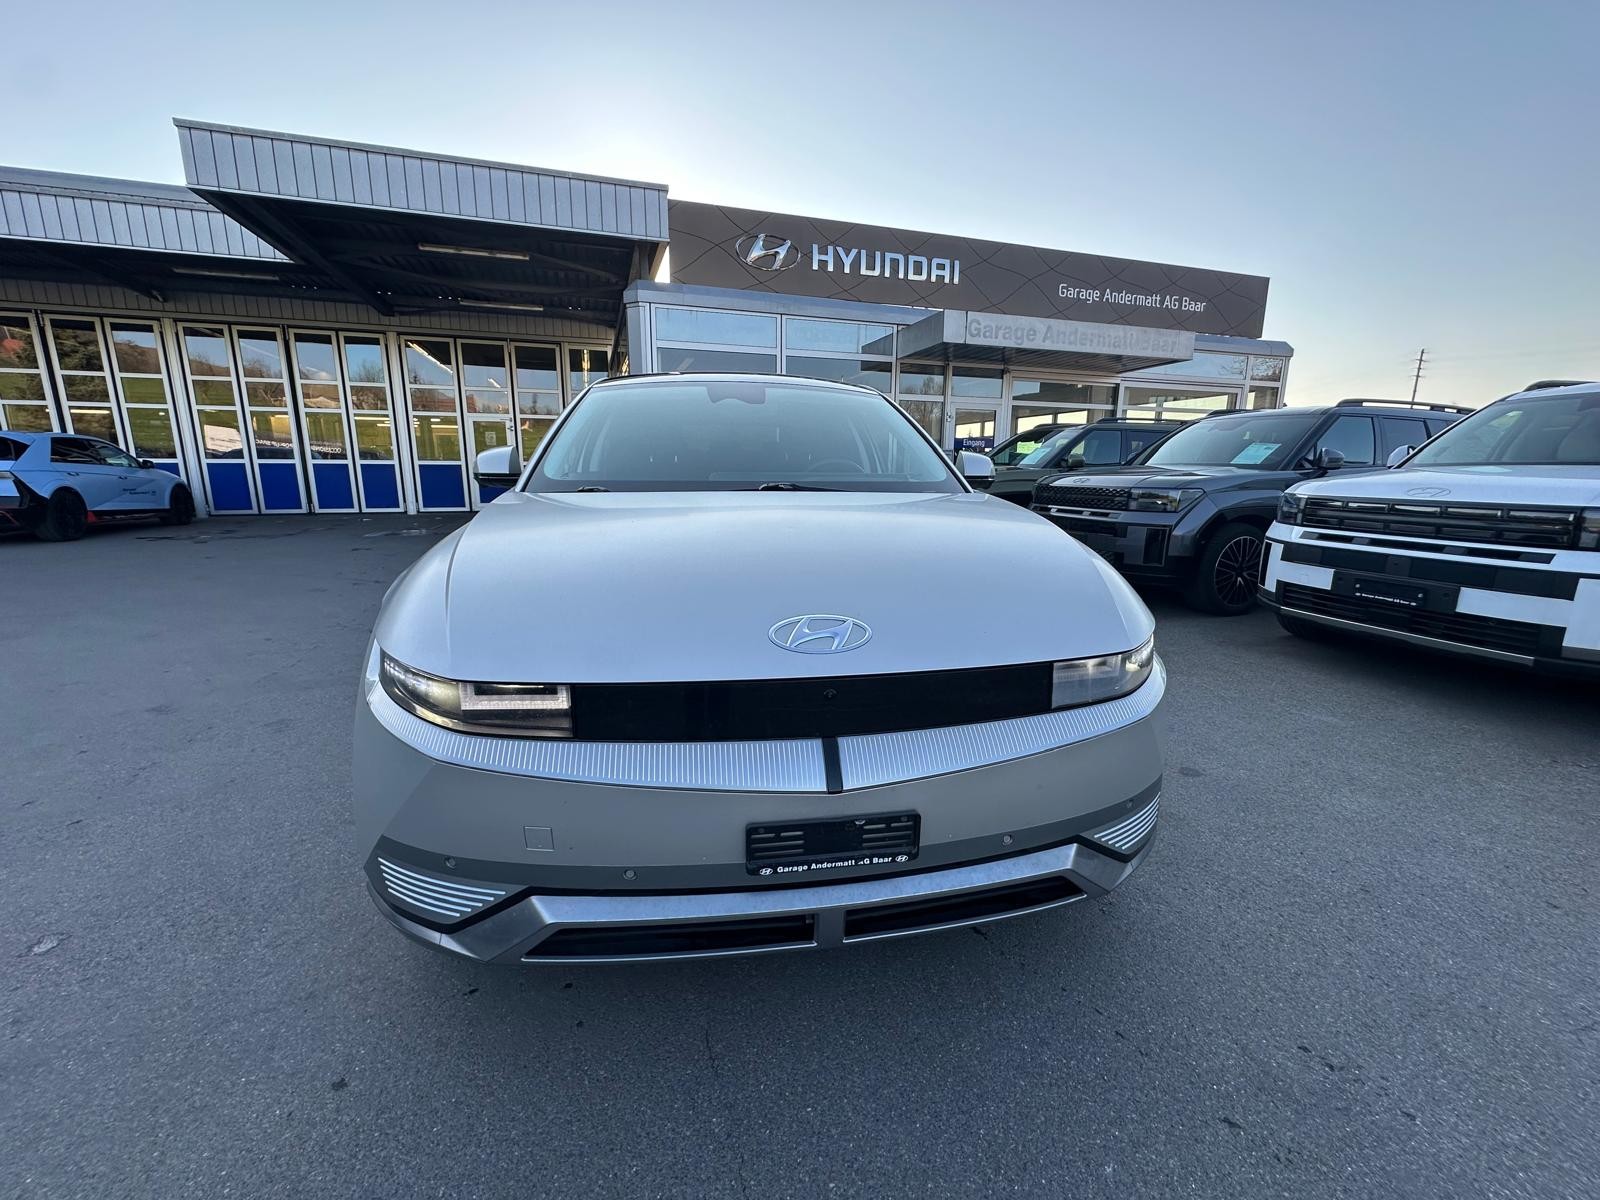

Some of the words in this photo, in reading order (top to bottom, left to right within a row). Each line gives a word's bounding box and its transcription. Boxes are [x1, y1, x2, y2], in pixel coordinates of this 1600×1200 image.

[812, 243, 960, 285] HYUNDAI
[1058, 283, 1100, 303] Garage
[1103, 288, 1161, 308] Andermatt
[1163, 295, 1180, 310] AG
[1181, 297, 1207, 312] Baar
[967, 318, 1037, 346] Garage
[963, 439, 985, 447] Eingang
[777, 864, 808, 873] Garage
[811, 859, 855, 869] Andermatt
[873, 856, 892, 864] Baar
